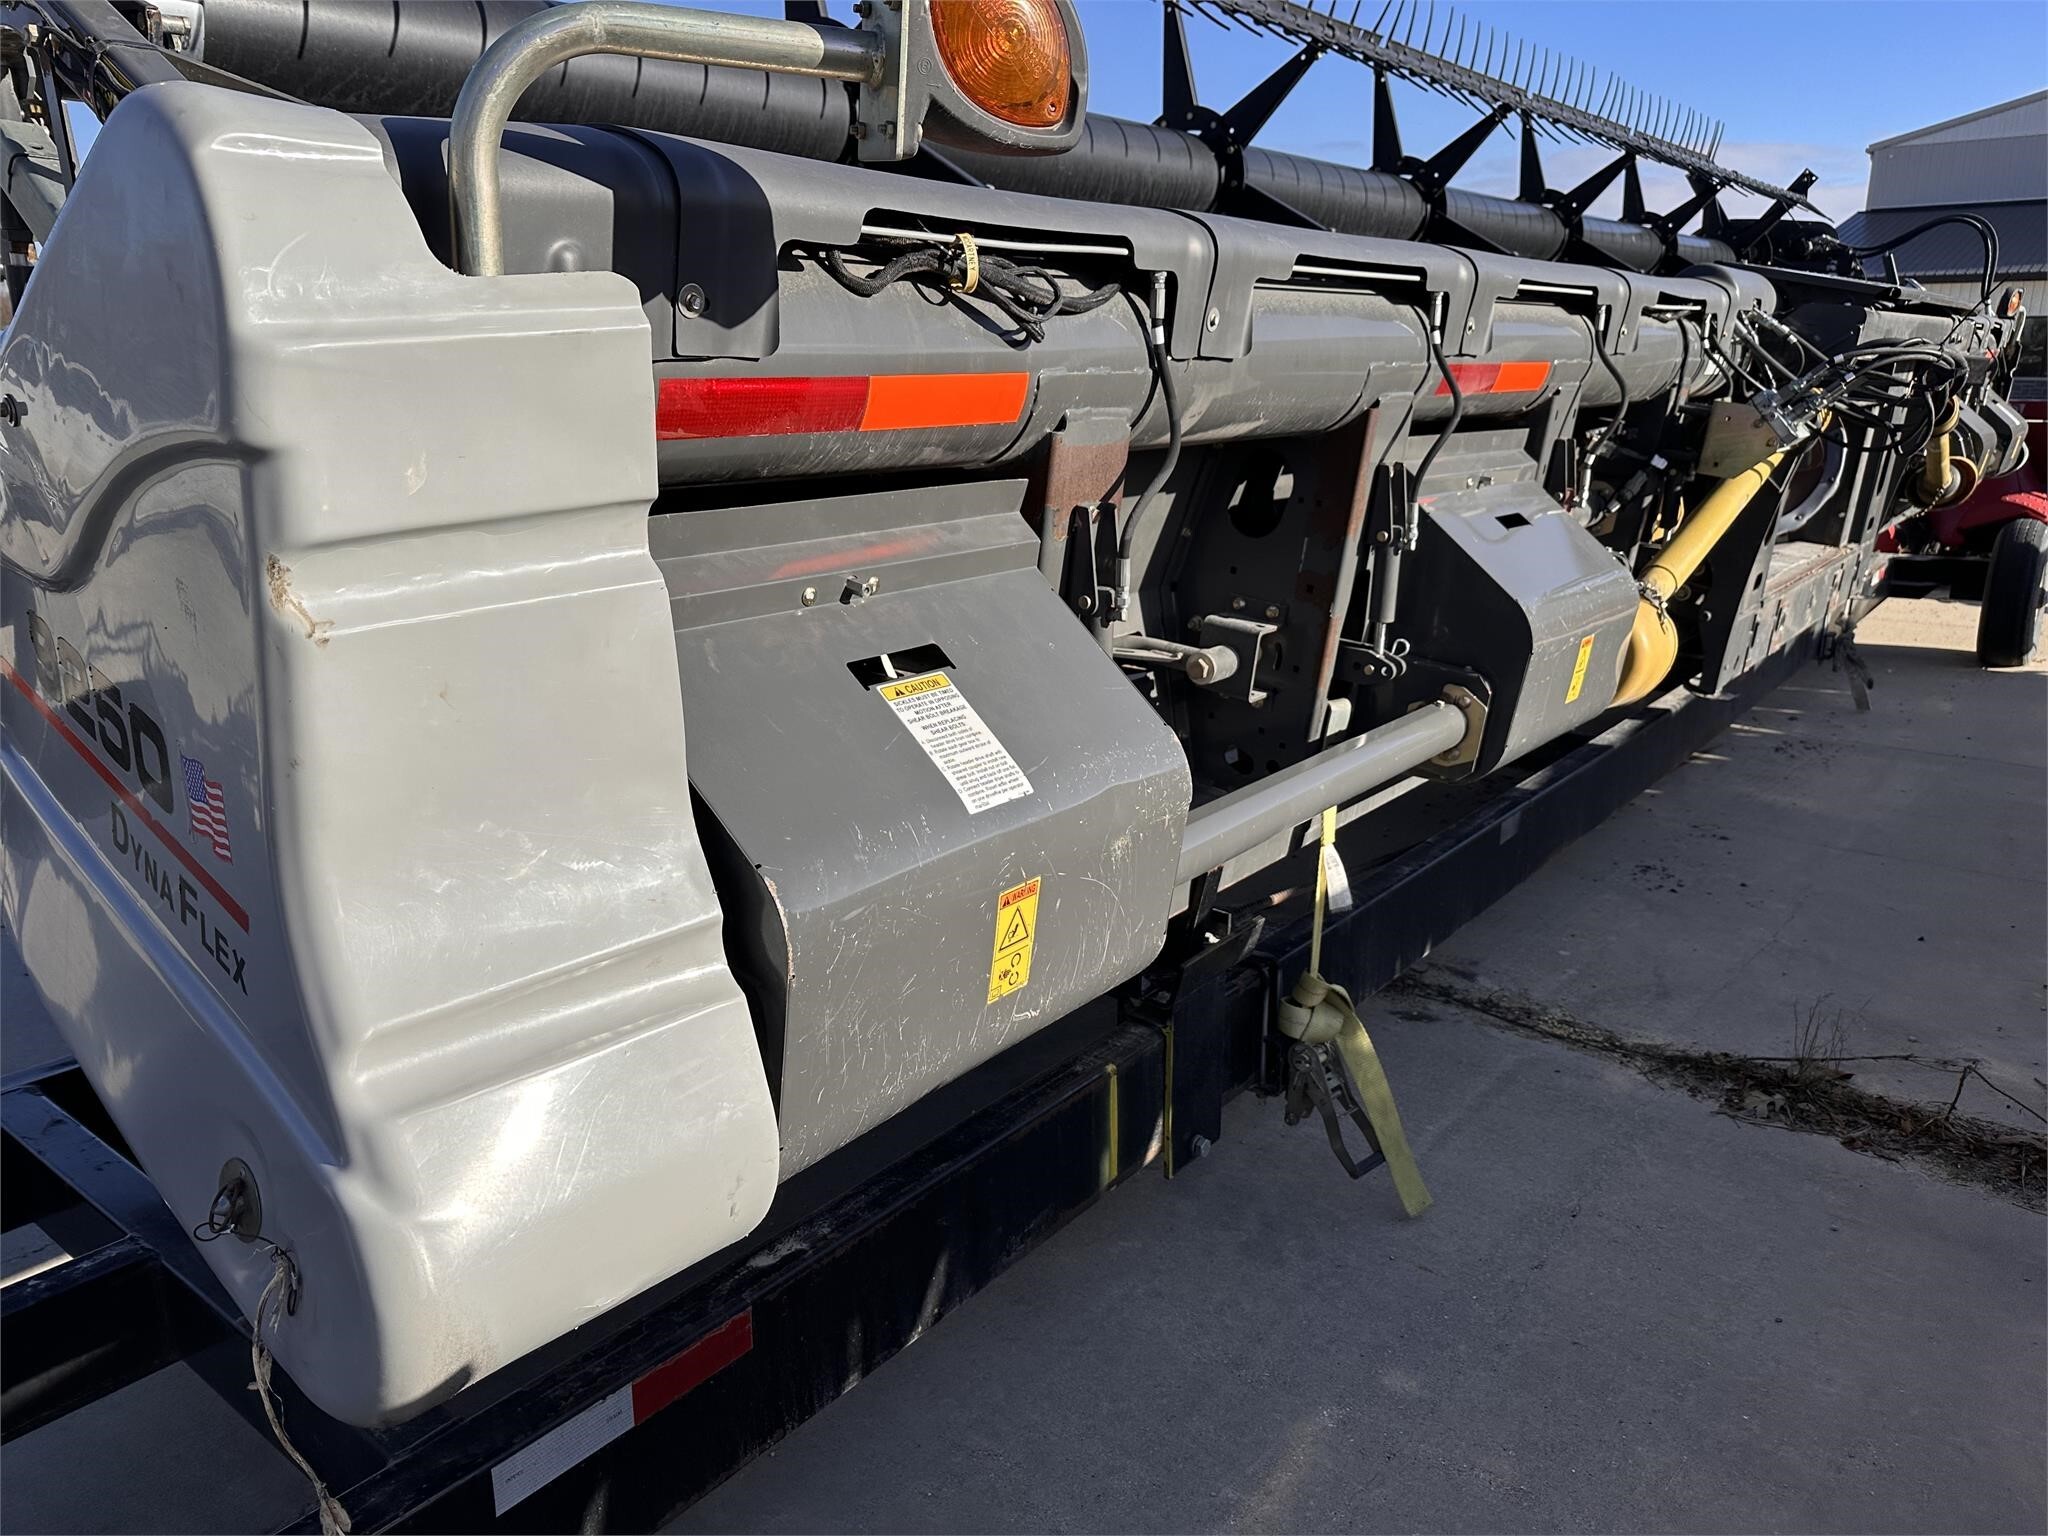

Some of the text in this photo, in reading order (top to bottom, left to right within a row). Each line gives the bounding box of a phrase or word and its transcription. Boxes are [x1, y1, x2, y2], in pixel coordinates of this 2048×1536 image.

[904, 678, 941, 694] CAUTION
[893, 698, 916, 706] SICKLES
[904, 701, 928, 711] OPERATE
[933, 693, 960, 703] OPPOSING
[27, 609, 174, 814] 9250
[907, 716, 926, 724] SHEAR
[938, 704, 968, 715] BREAKAGE
[914, 706, 936, 715] MOTION
[921, 714, 967, 730] WHEN REPLACING
[930, 722, 966, 735] SHEAR BOLTS
